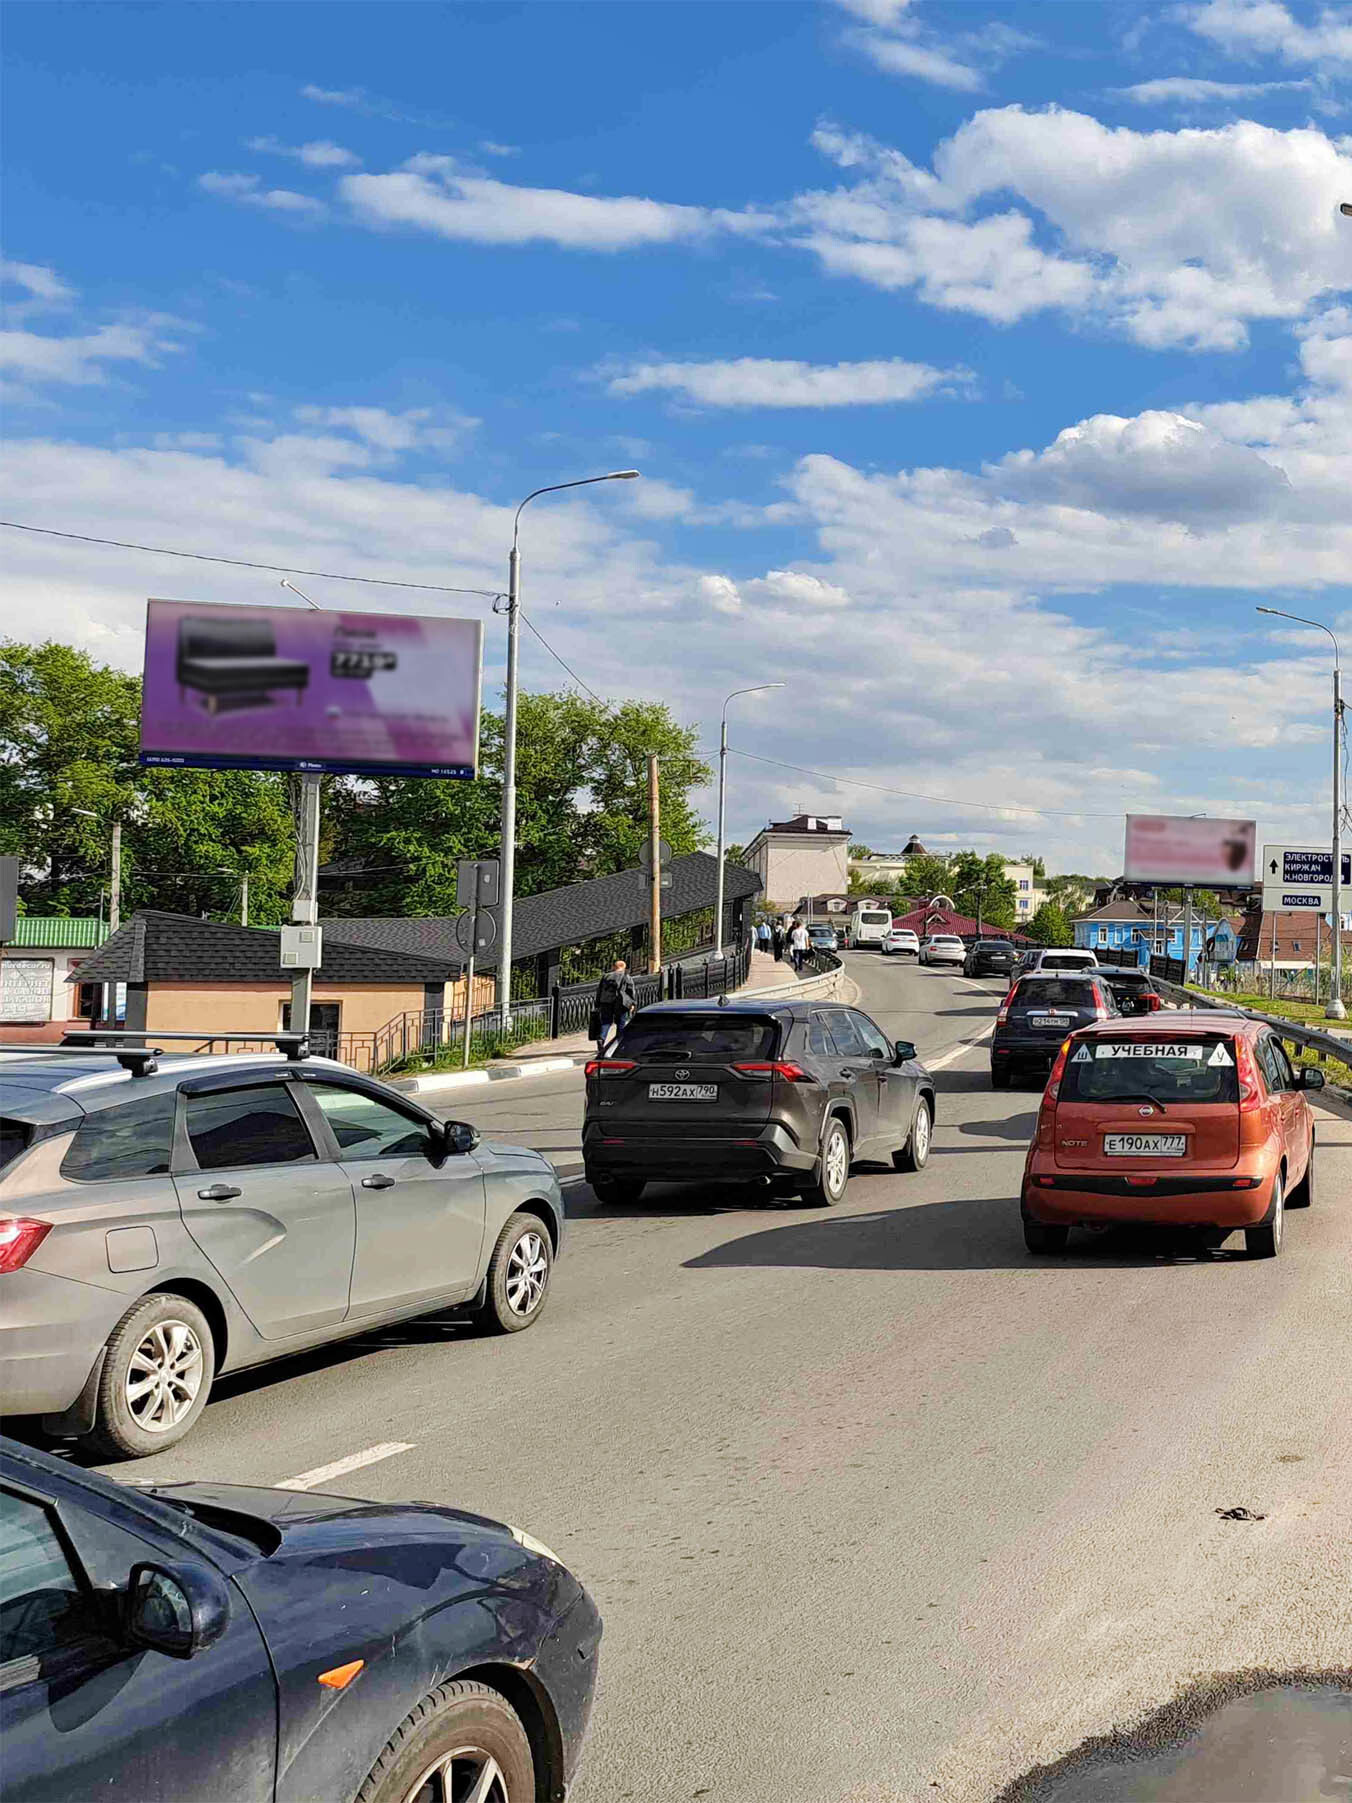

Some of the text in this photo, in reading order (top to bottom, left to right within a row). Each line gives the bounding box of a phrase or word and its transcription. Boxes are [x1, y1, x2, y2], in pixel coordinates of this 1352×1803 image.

[1285, 853, 1350, 863] ЭЛЕКТРОСТЛЬ
[1284, 863, 1321, 871] КИРЖАЧ
[1284, 896, 1319, 905] МОСКВА
[1111, 1045, 1188, 1057] УЧЕБНАЯ
